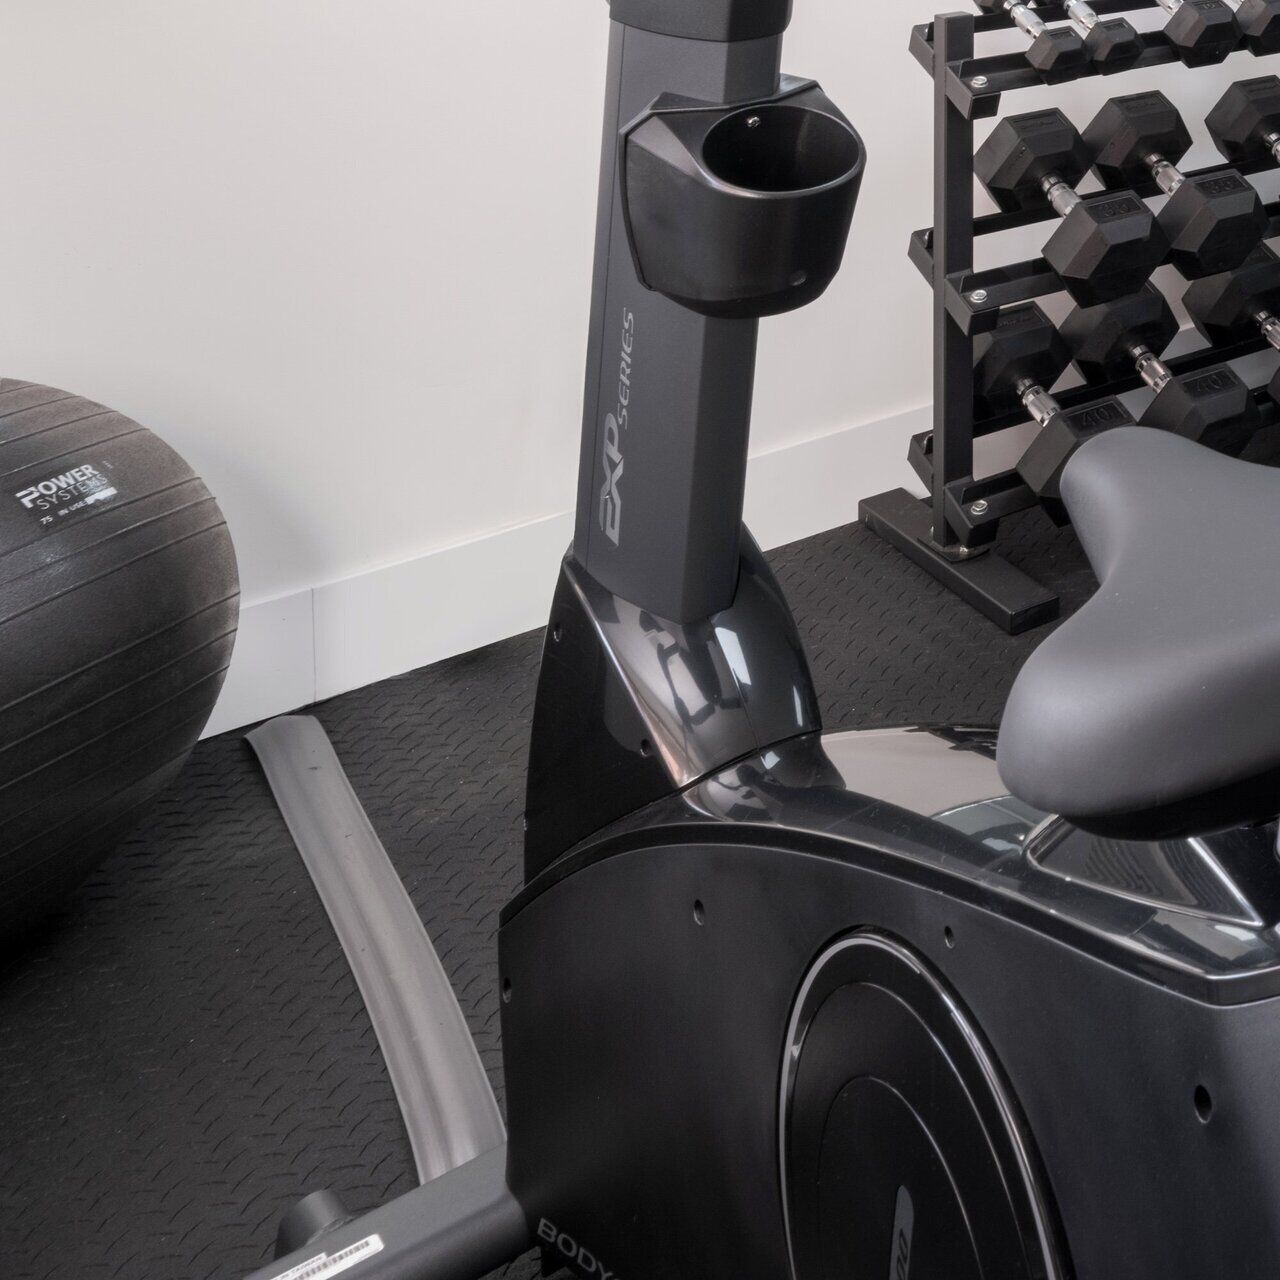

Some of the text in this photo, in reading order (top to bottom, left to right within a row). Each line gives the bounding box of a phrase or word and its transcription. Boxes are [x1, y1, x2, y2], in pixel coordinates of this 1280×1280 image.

[599, 307, 634, 548] EXP SERIES
[1081, 406, 1112, 426] 40
[14, 464, 100, 509] POWER
[36, 473, 108, 511] SYSTEMS
